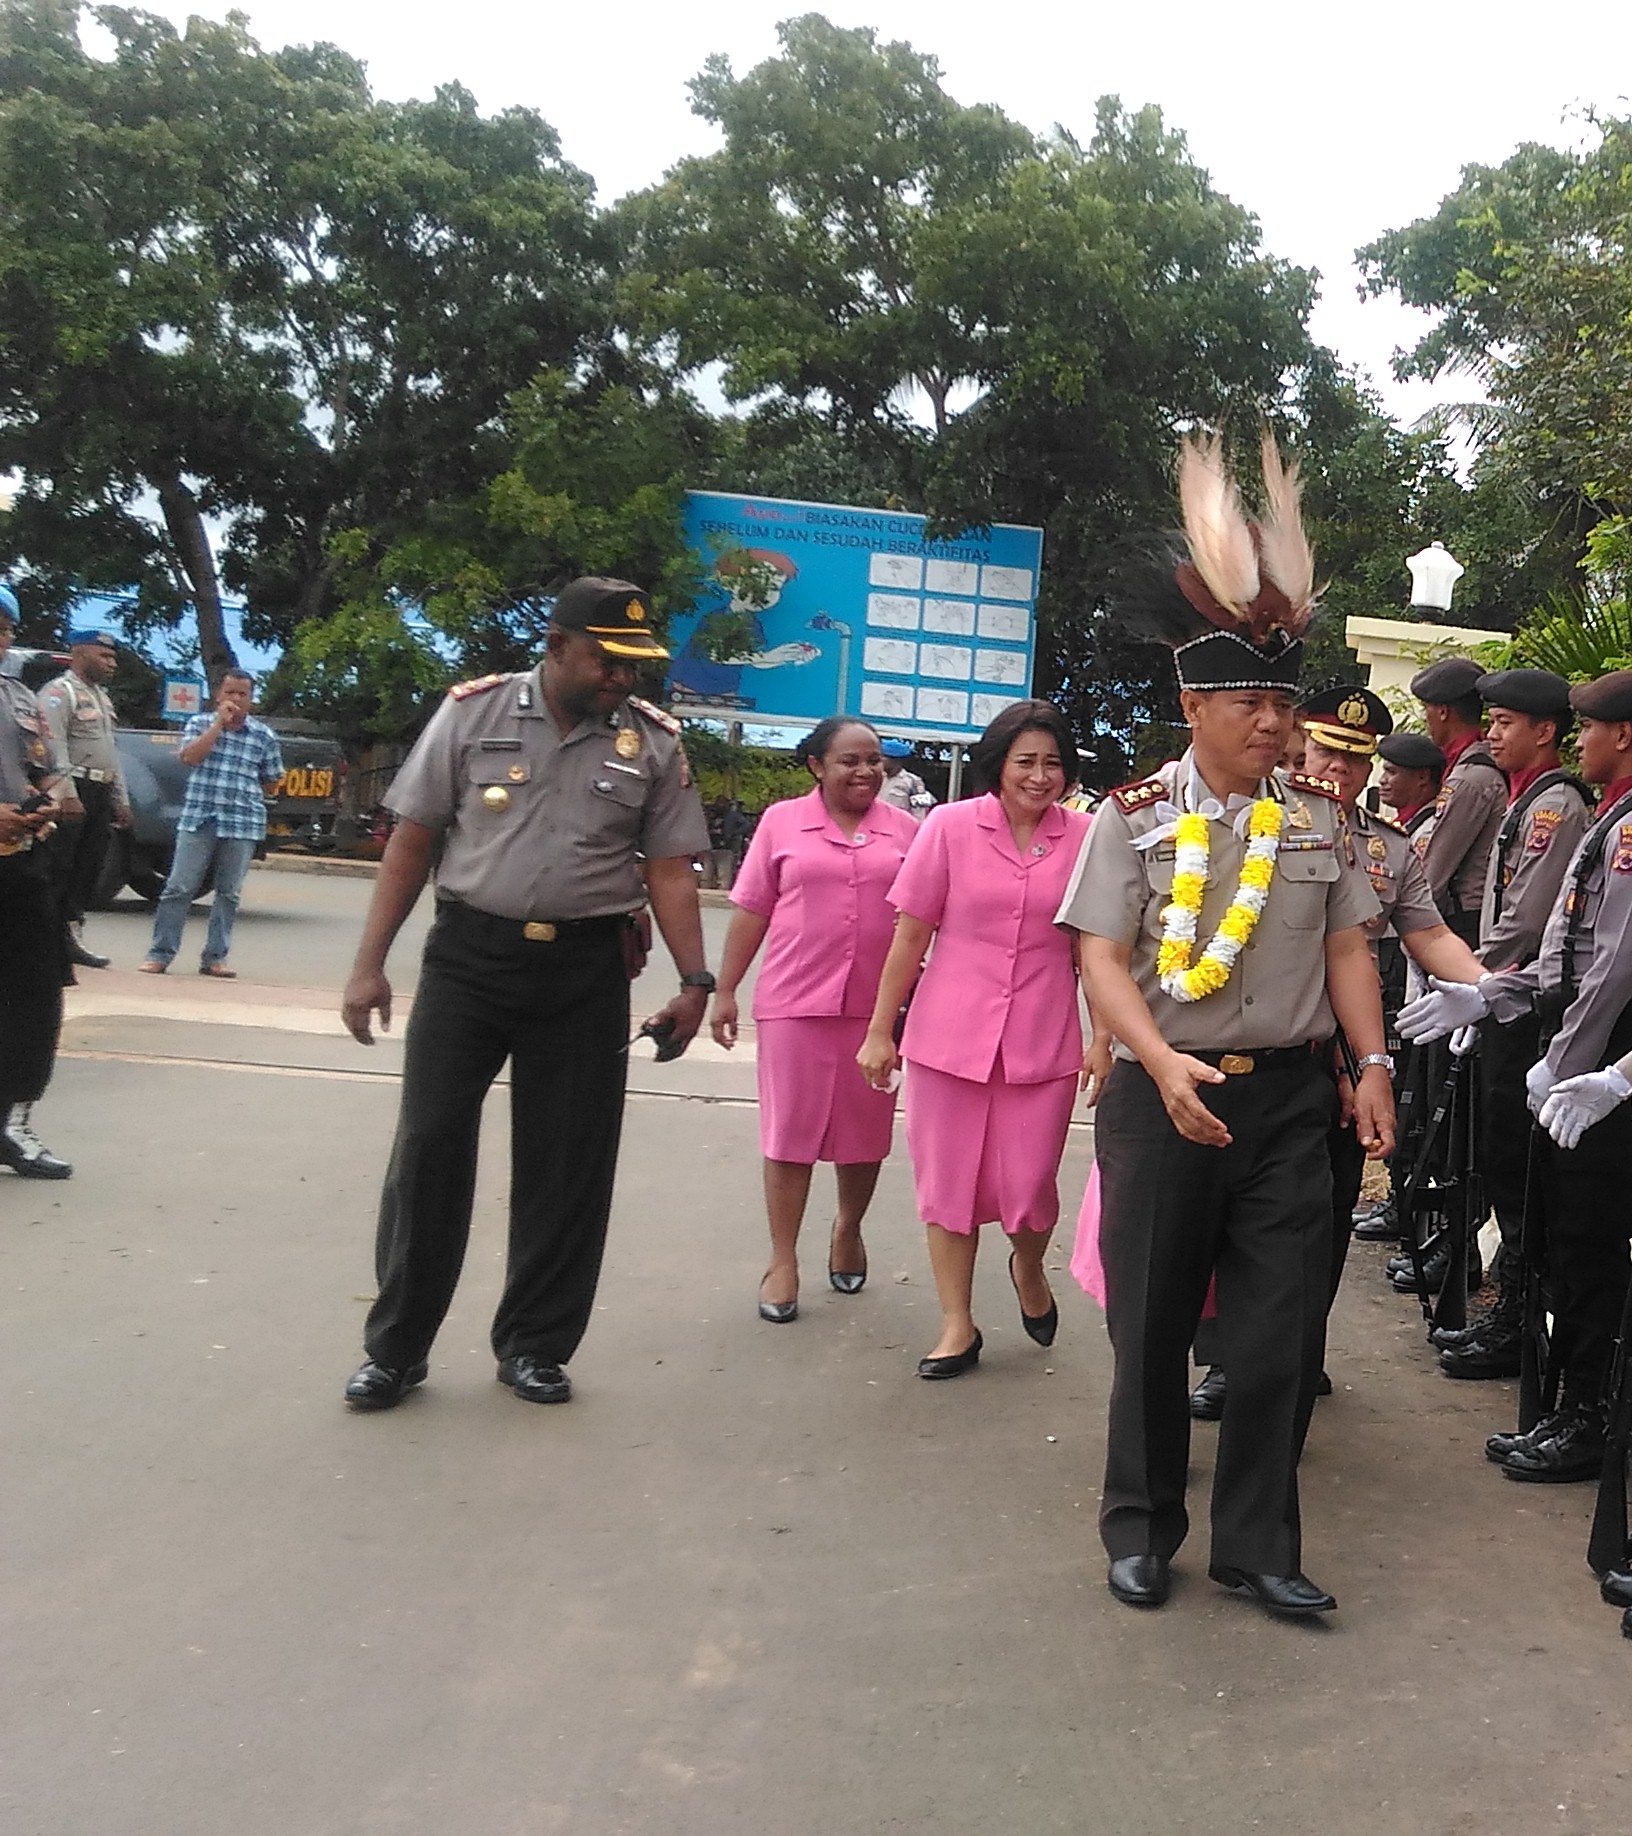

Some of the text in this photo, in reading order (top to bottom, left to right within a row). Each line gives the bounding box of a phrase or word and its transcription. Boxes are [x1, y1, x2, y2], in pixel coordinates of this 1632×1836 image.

[805, 511, 884, 533] BIASAKAN
[773, 527, 808, 542] DAN
[813, 531, 883, 550] SESUDAH
[888, 540, 991, 562] BERAKTIFITAS
[275, 768, 334, 797] POLISI
